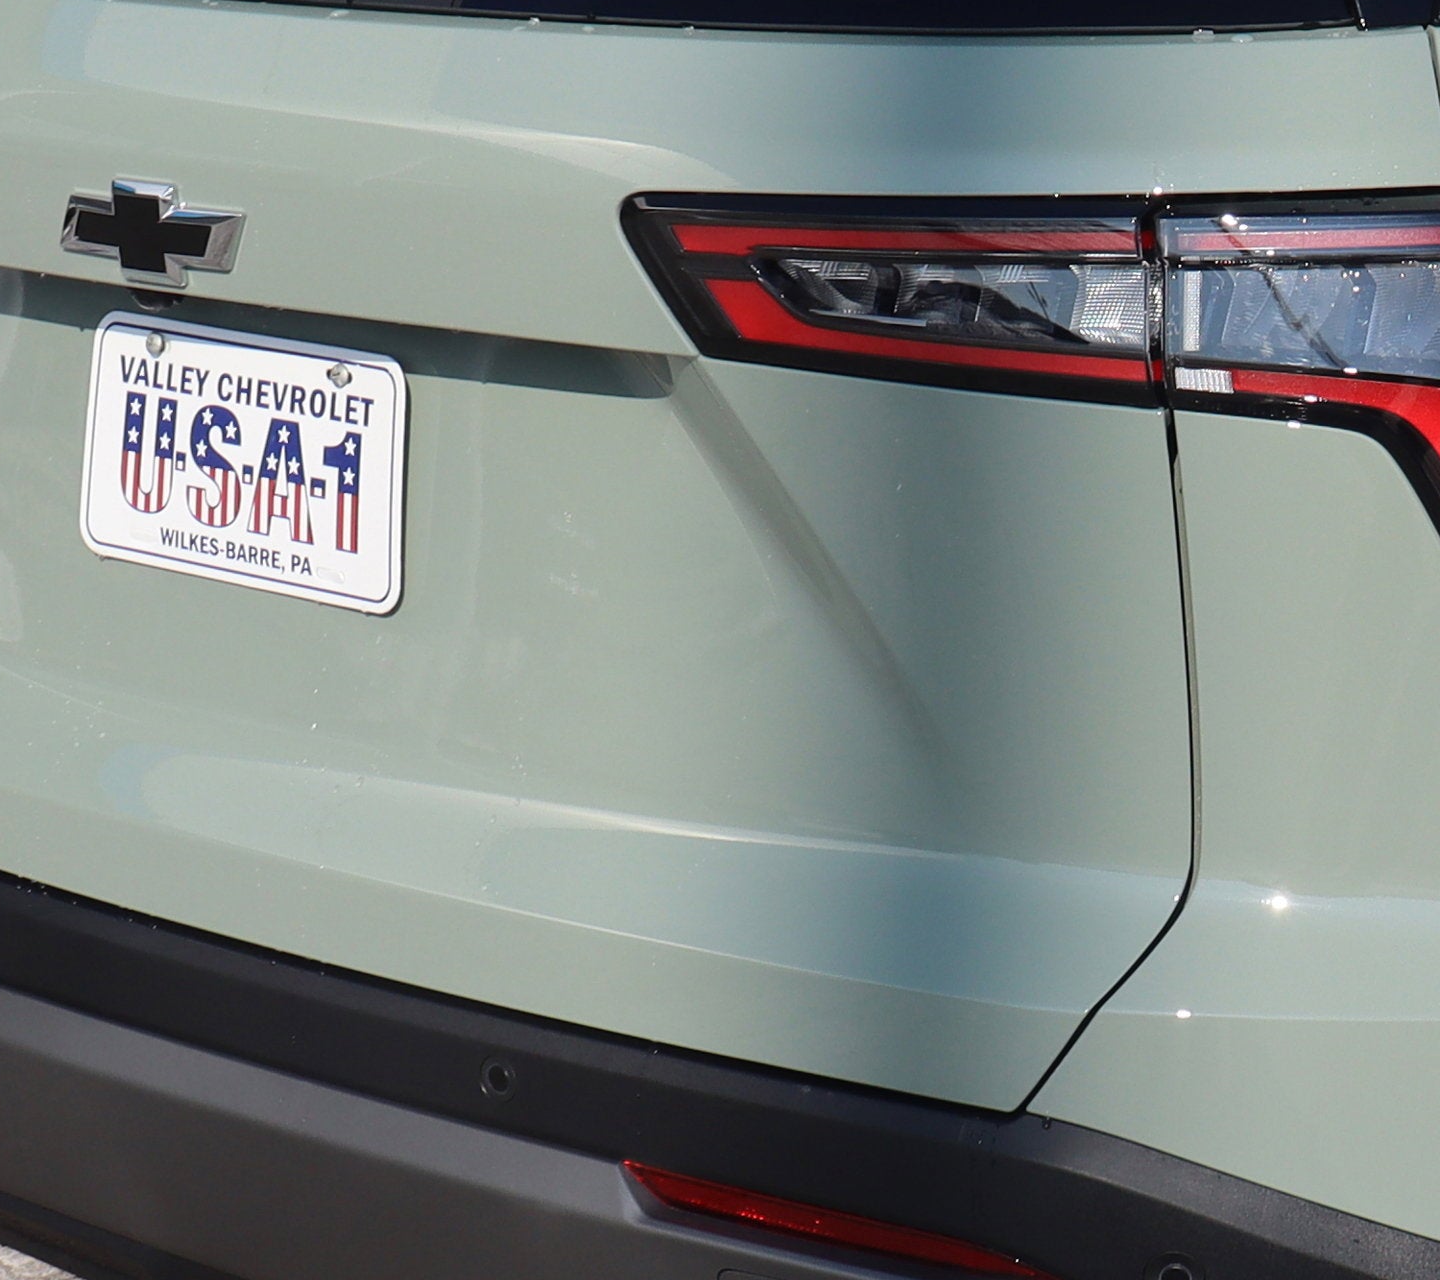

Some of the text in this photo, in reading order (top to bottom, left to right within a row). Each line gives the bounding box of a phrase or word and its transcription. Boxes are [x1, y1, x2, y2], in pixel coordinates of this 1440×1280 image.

[120, 354, 375, 428] VALLEY CHEVROLET
[160, 526, 313, 577] WILKES-BARRE, PA
